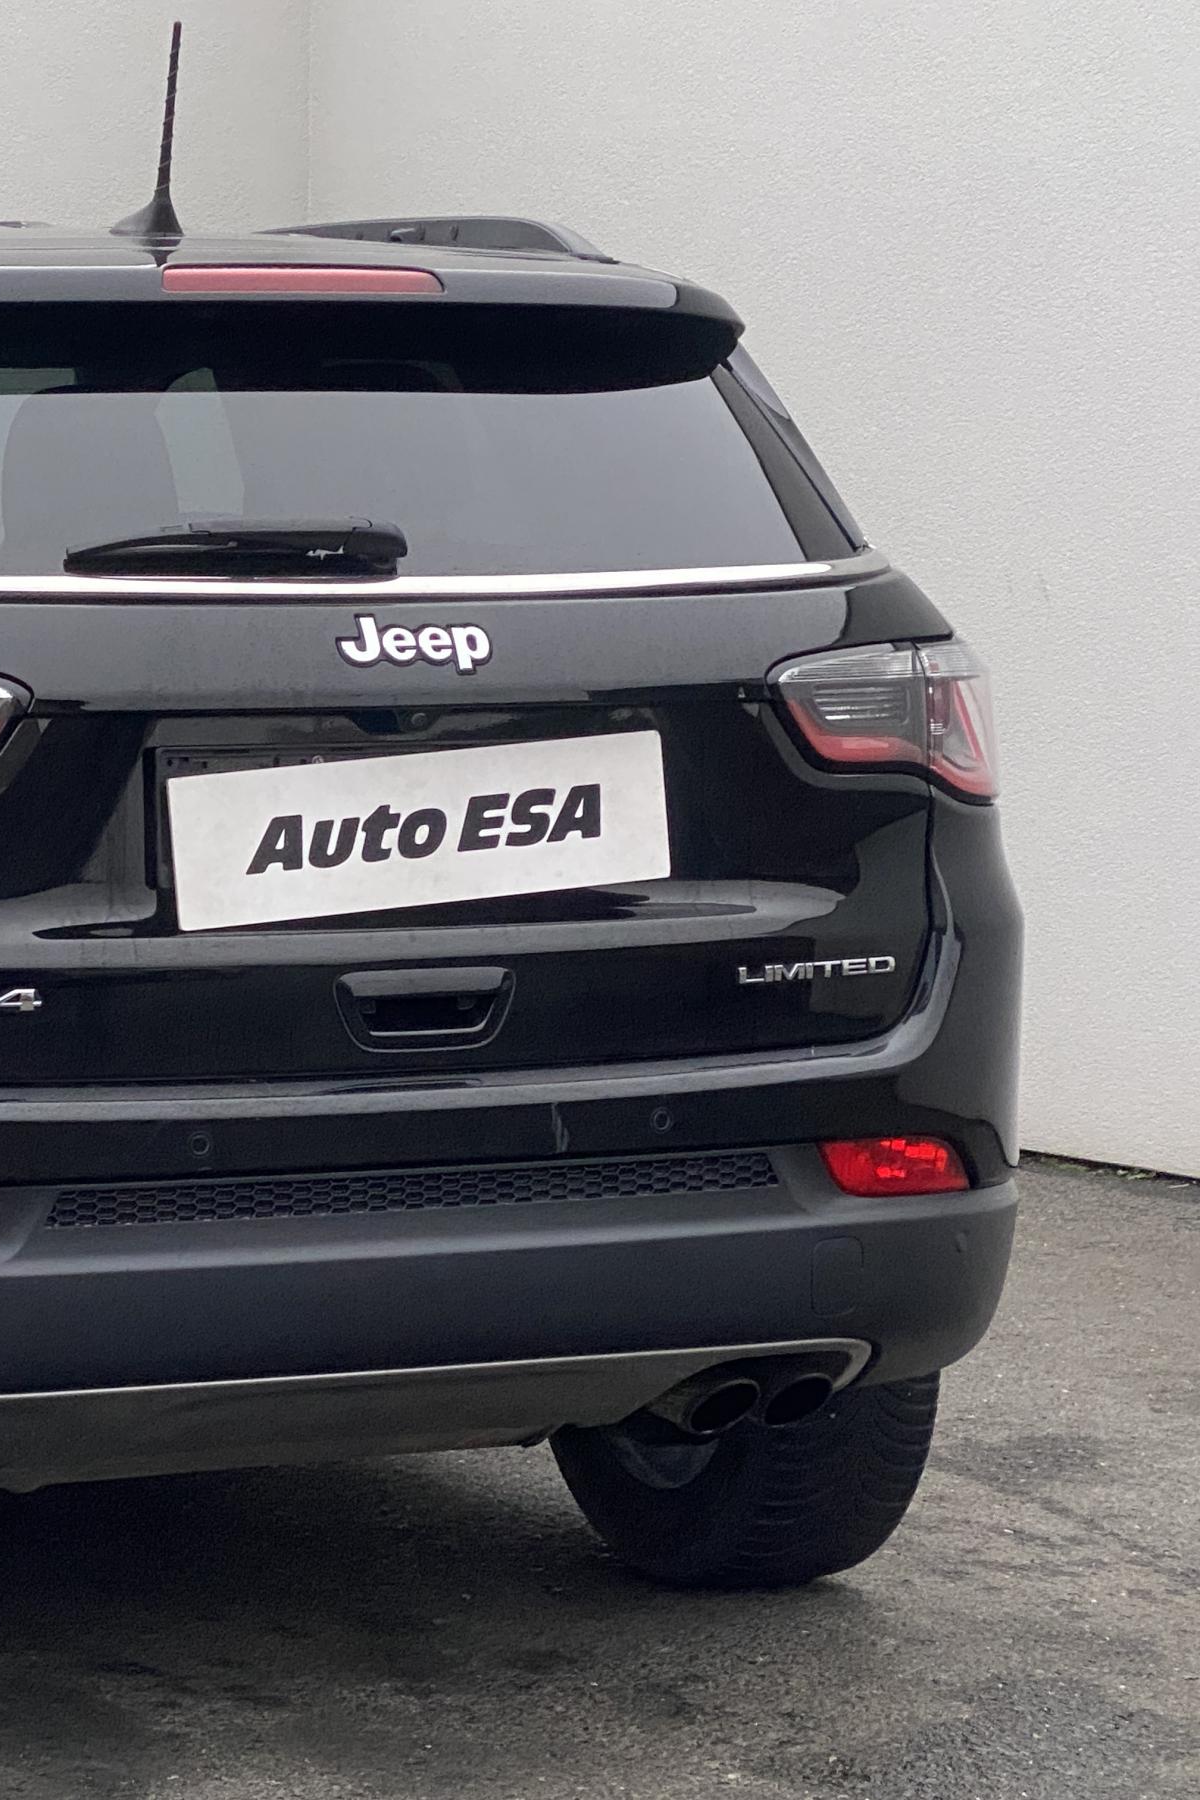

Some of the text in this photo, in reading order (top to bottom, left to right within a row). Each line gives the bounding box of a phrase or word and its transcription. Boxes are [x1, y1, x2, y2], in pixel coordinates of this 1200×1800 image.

[337, 613, 492, 673] Jeep
[246, 784, 601, 875] Auto ESA
[738, 955, 896, 984] LIMITED
